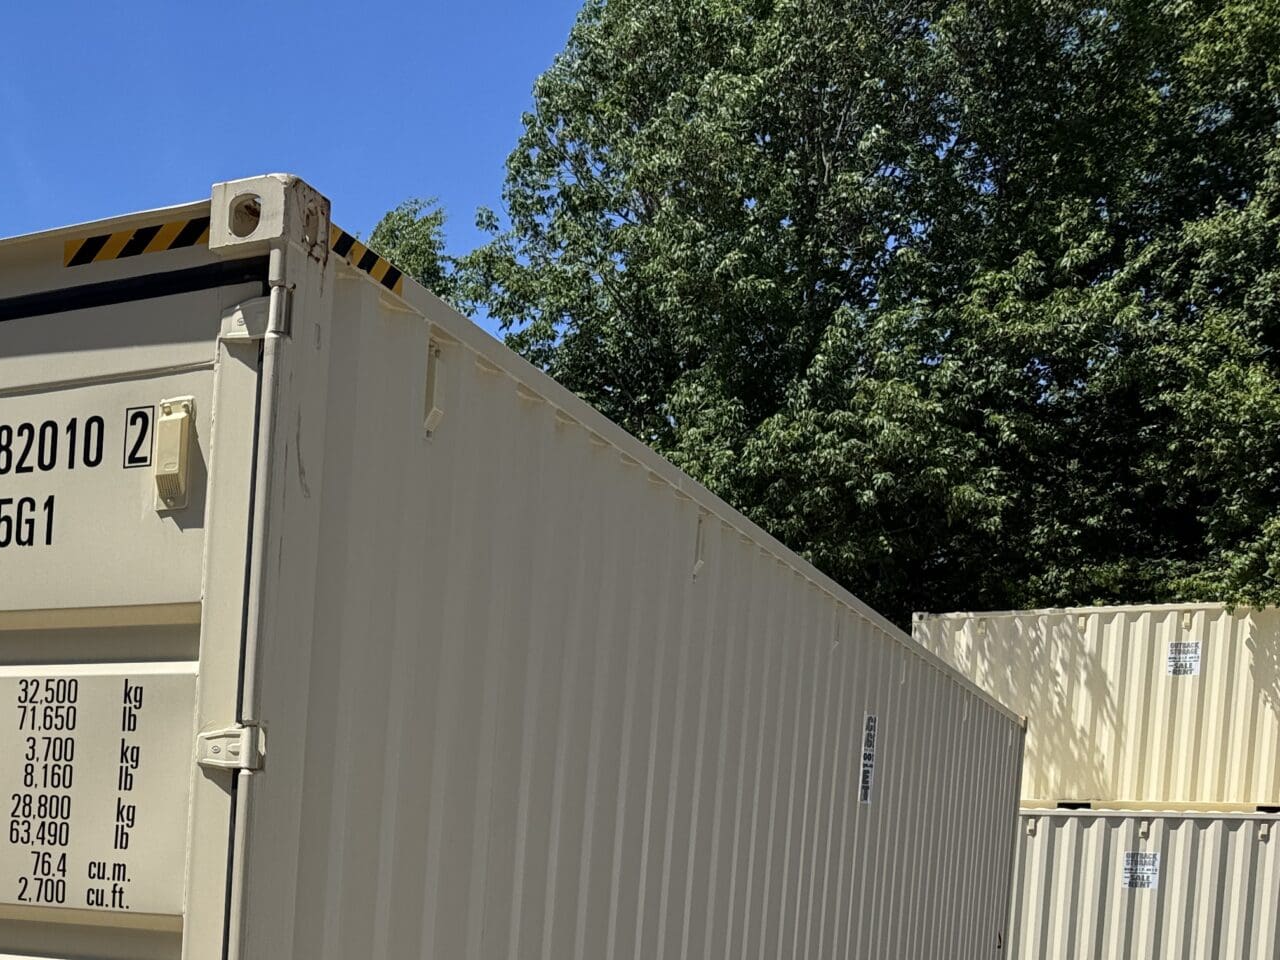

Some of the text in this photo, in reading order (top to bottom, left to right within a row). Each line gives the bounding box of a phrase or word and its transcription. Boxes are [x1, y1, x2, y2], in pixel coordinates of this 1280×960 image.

[127, 410, 149, 465] 2
[17, 678, 143, 709] 32,500 kg
[17, 706, 137, 732] 71,650 lb
[25, 737, 140, 769] 3,700 kg
[23, 764, 133, 791] 8,160 lb
[11, 794, 136, 828] 28,800 kg
[9, 820, 129, 850] 63,490 lb
[31, 851, 131, 882] 76.4 cu.m.
[18, 877, 130, 909] 2,700 cu.ft.
